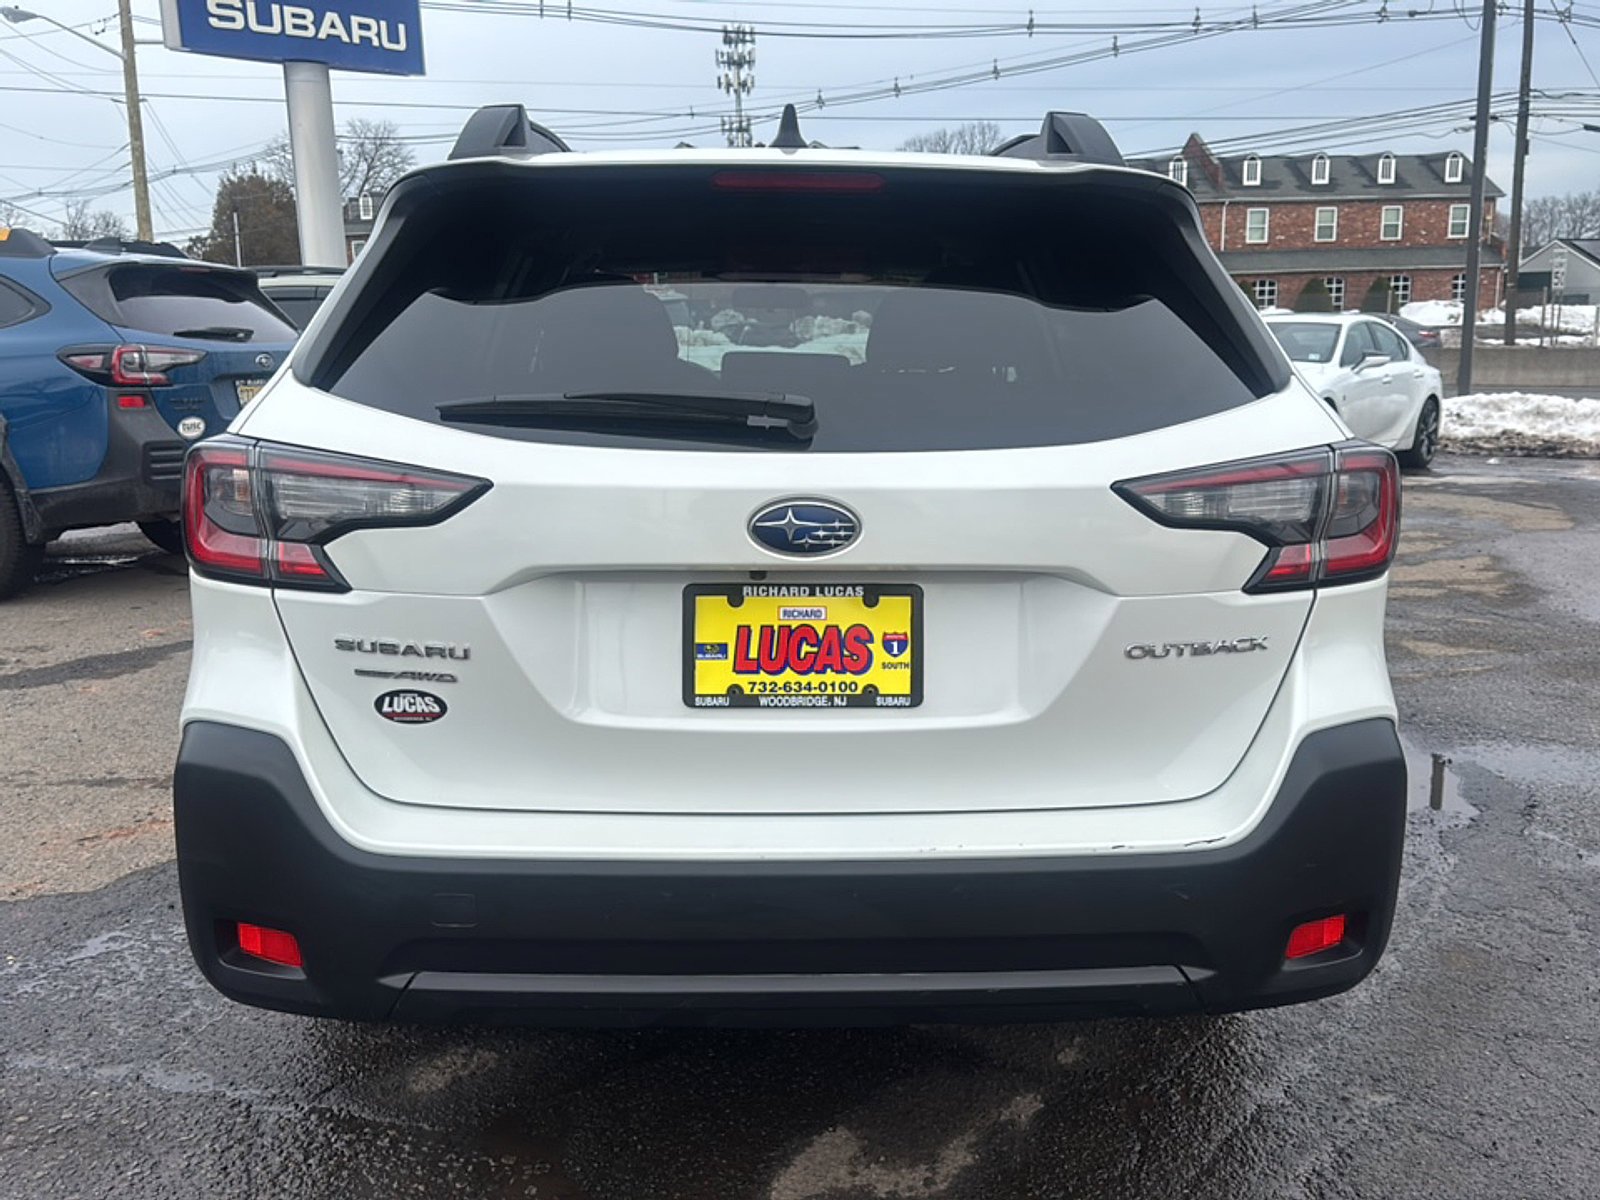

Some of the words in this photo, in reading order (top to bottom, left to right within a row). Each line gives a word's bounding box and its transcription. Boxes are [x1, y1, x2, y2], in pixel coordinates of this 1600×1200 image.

[206, 0, 407, 51] SUBARU
[743, 586, 809, 597] RICHARD
[815, 586, 864, 597] LUCAS
[782, 608, 822, 619] RICHARD
[335, 637, 471, 661] SUBARU
[733, 624, 874, 675] LUCAS
[890, 640, 900, 655] 1
[1124, 636, 1268, 660] OUTBACK
[881, 661, 910, 670] SOUTH
[394, 670, 458, 683] AWD
[748, 681, 859, 694] 732-634-0100
[382, 696, 440, 713] LUCAS
[695, 696, 730, 707] SUBARU
[833, 695, 847, 707] NJ
[876, 696, 911, 707] SUBARU
